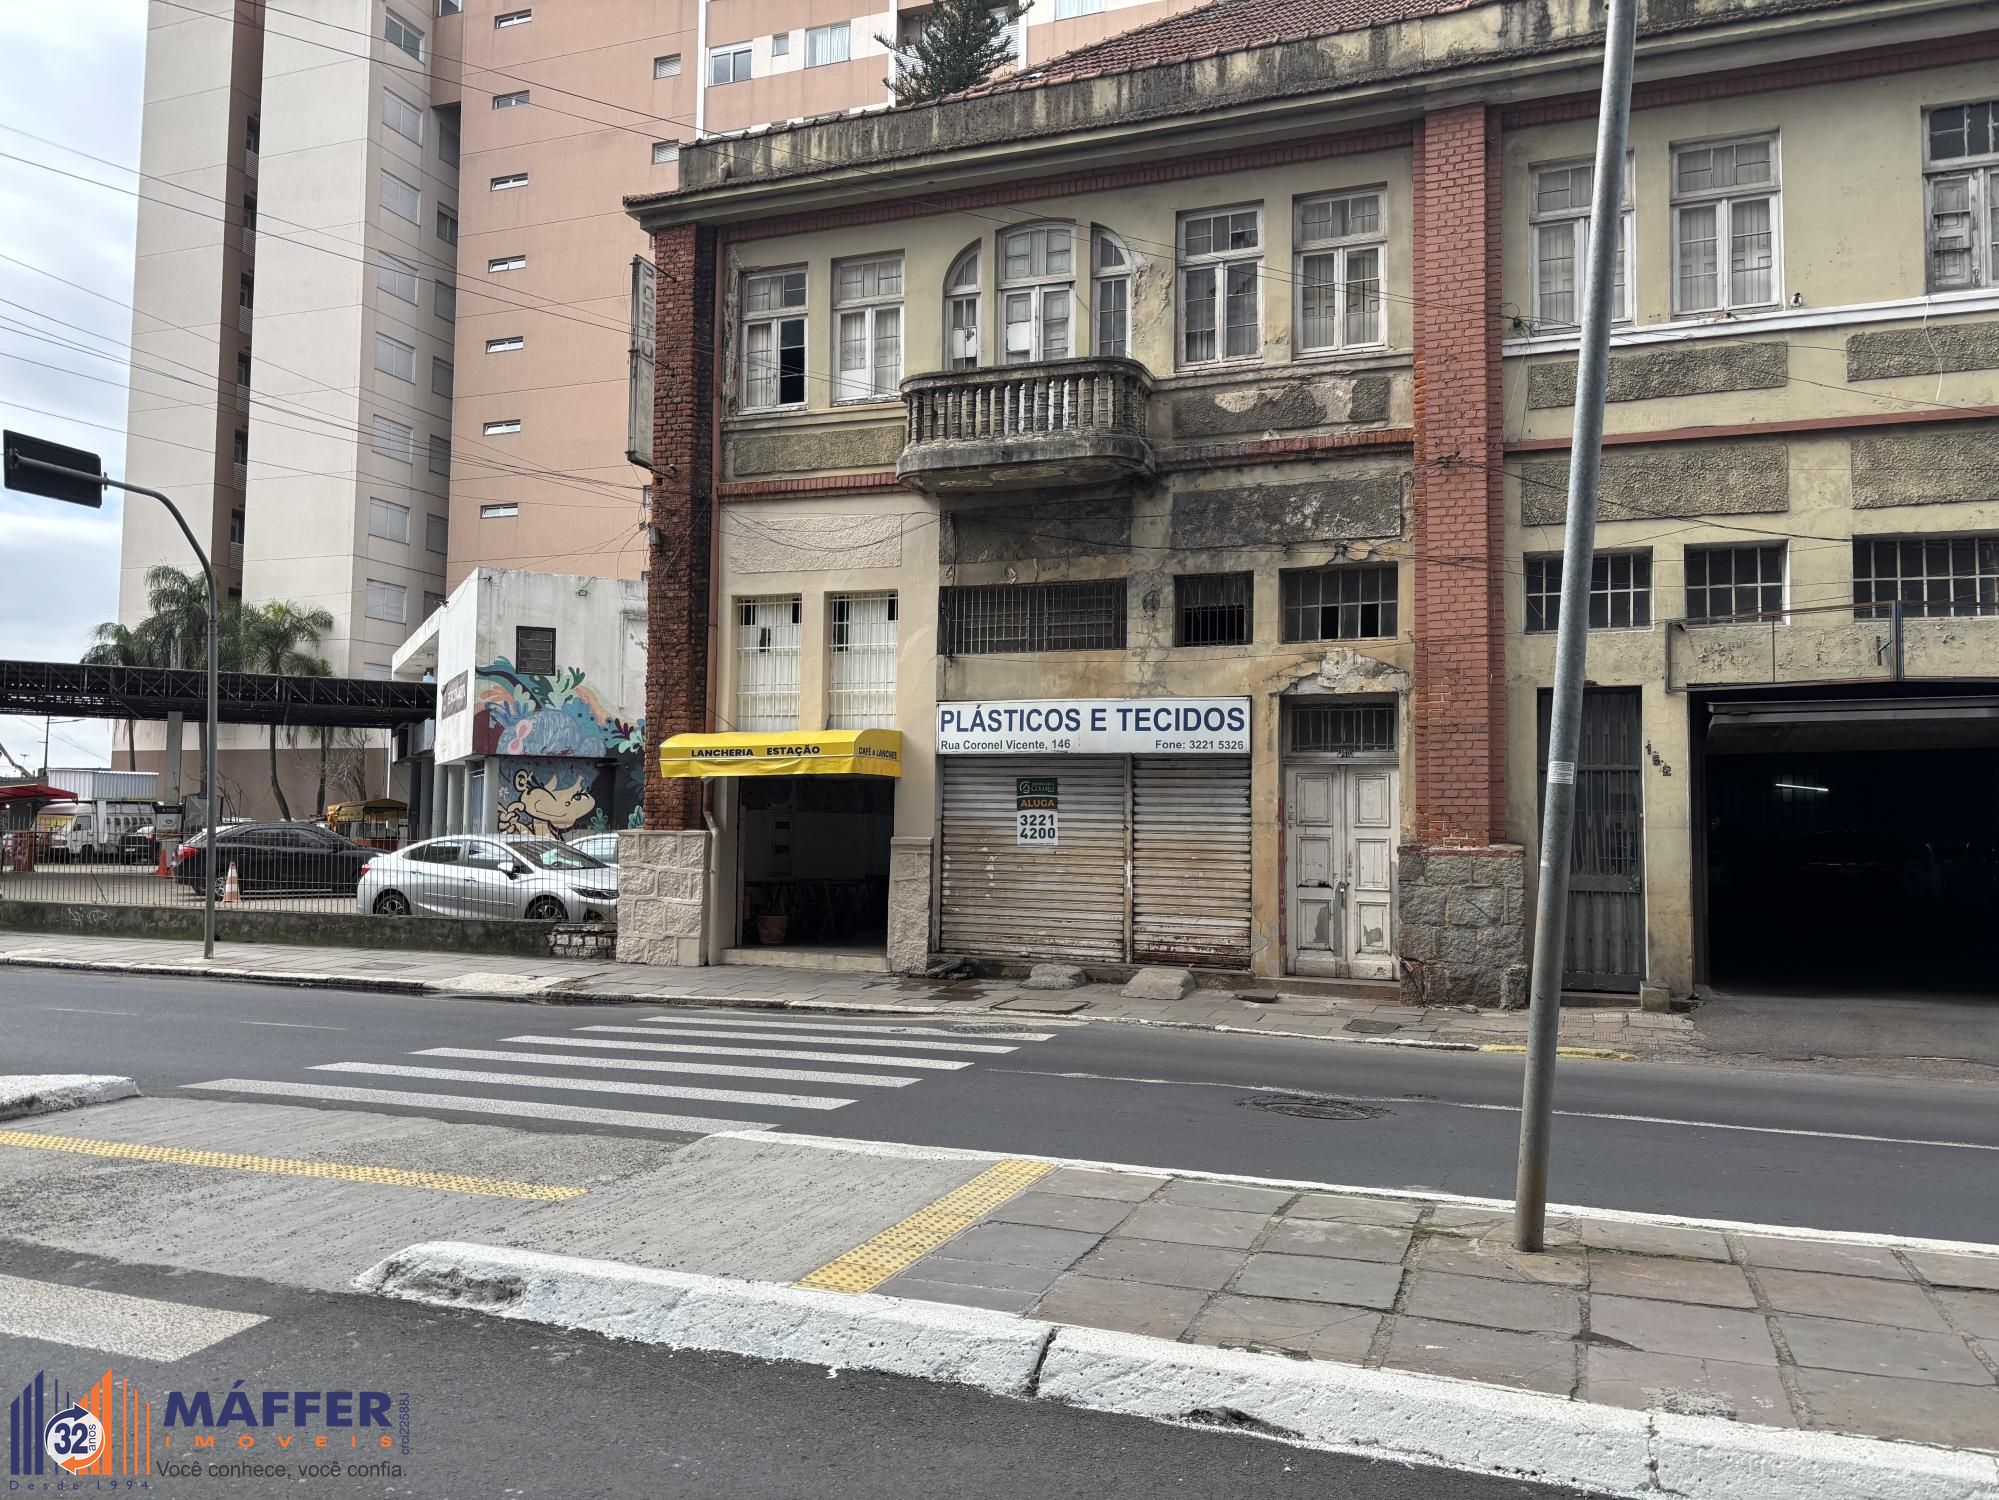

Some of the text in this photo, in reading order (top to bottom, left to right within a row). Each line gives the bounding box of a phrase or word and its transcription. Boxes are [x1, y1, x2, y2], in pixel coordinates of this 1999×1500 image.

[940, 704, 1245, 732] PLÁSTICOS E TECIDOS
[691, 745, 821, 757] LANCHERIA ESTAÇÃO
[940, 739, 1071, 751] Rua Coronel Vicente, 146
[1155, 740, 1244, 750] Fone: 3221 5326
[858, 746, 872, 756] CAFÉ
[876, 749, 897, 760] LANCHES
[1645, 743, 1672, 777] 152
[1020, 799, 1055, 808] ALUGA
[1020, 814, 1054, 826] 3221
[1020, 827, 1056, 839] 4200
